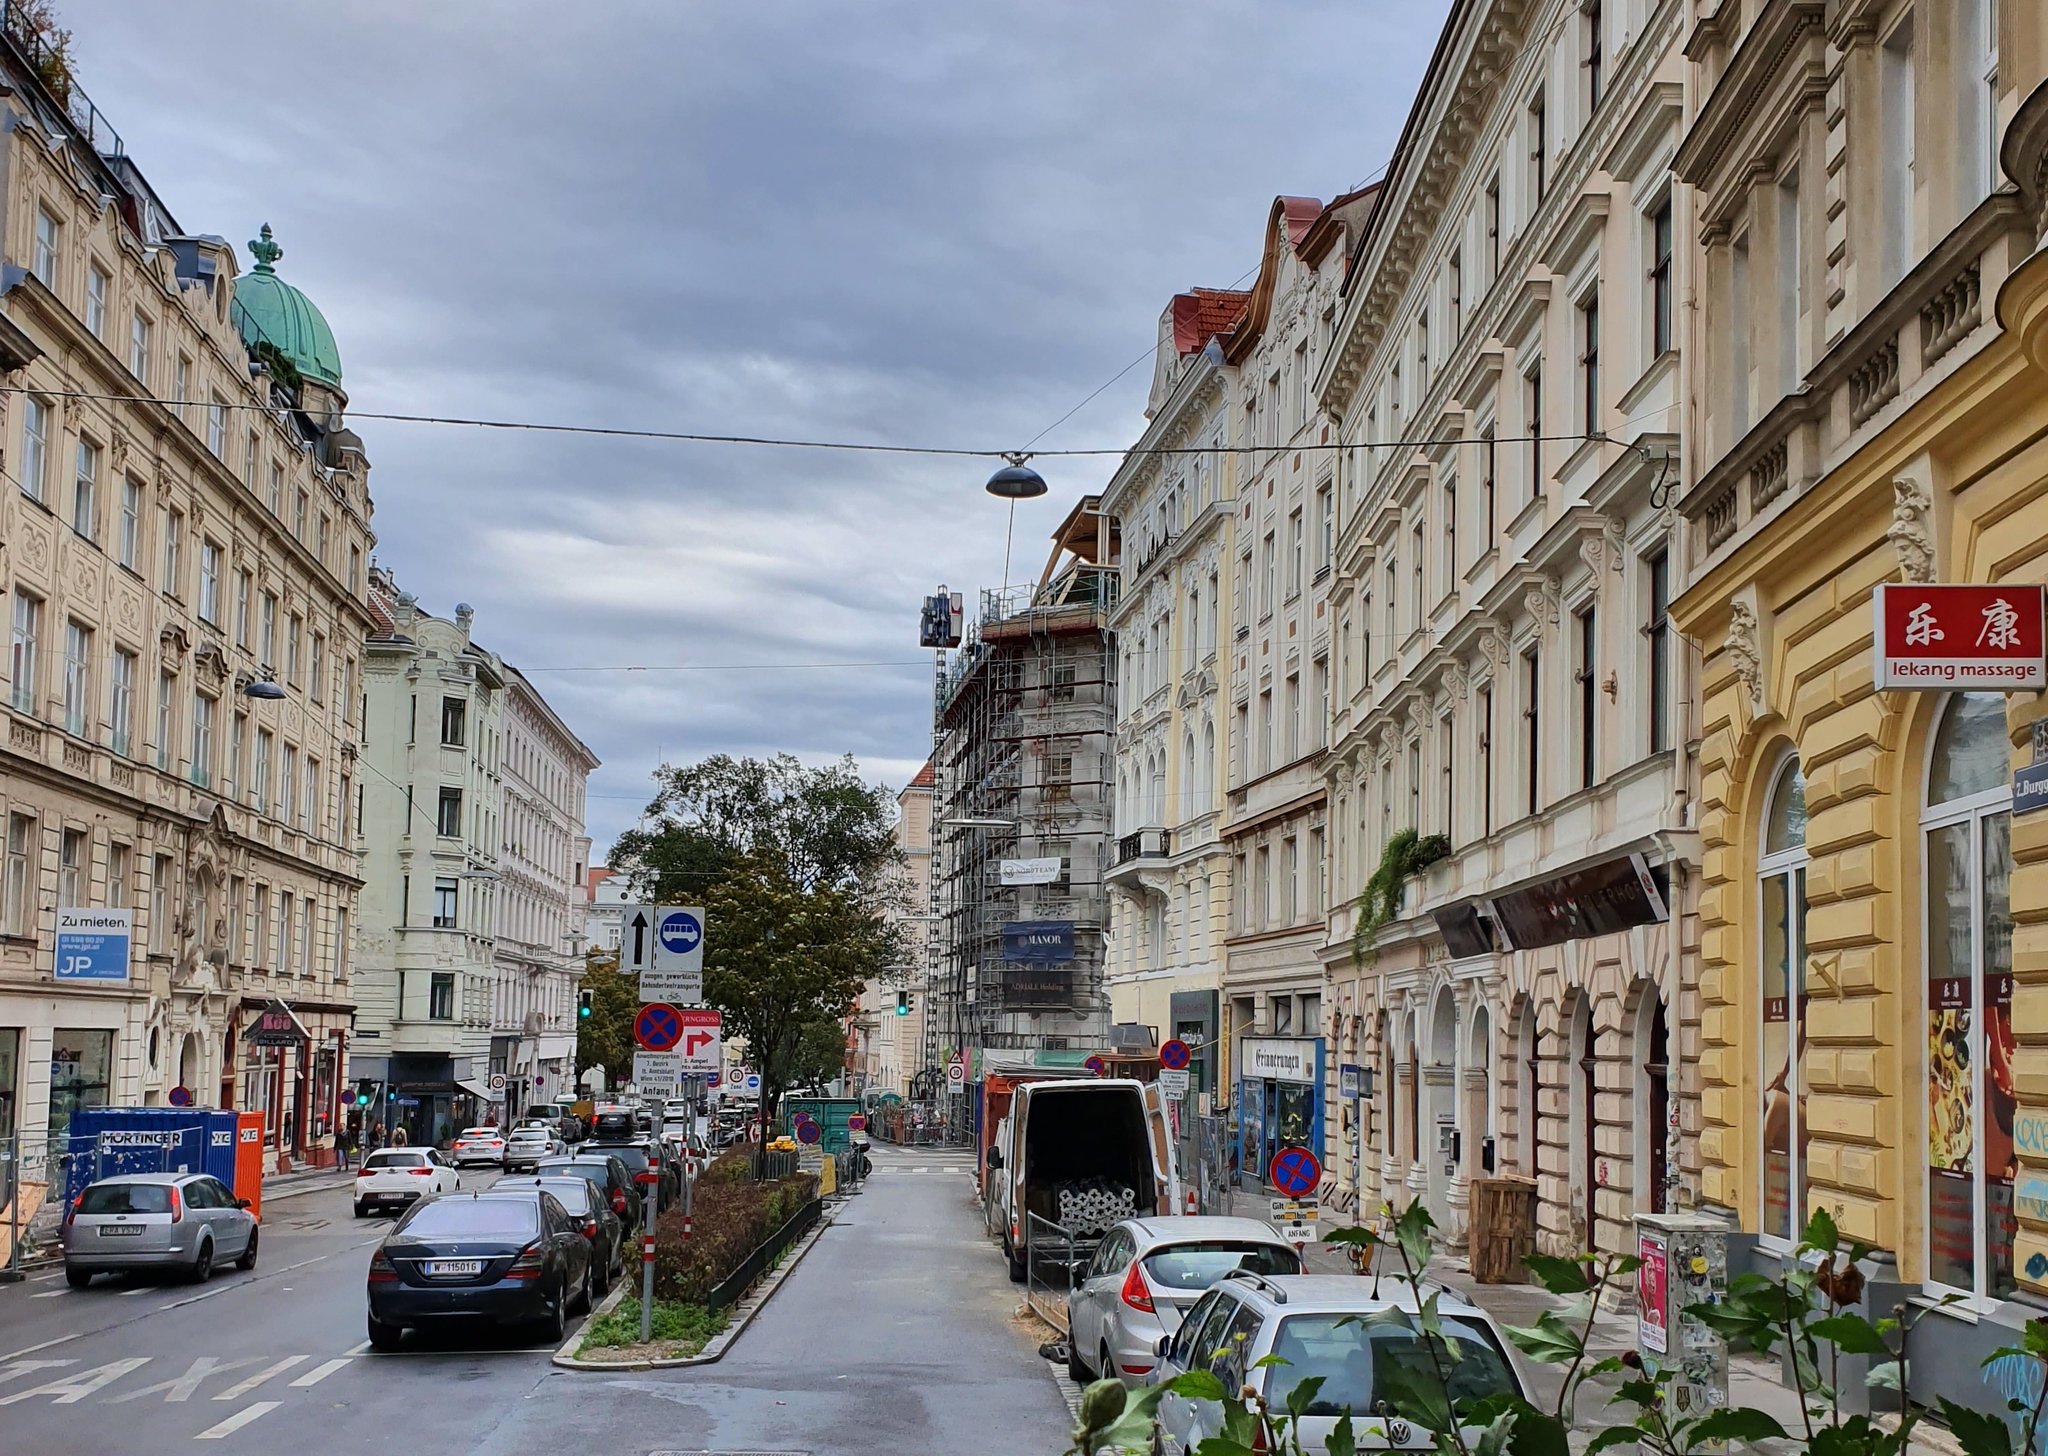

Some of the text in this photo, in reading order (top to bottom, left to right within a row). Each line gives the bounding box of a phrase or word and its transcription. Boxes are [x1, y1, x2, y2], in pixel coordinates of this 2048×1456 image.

[1893, 661, 2037, 680] lekang massage
[61, 915, 128, 928] Zu mieten.
[60, 955, 92, 975] JP
[1255, 1048, 1300, 1075] Erinnerungen
[643, 1086, 670, 1097] Anfang
[1272, 1202, 1284, 1210] Gilt
[1288, 1229, 1311, 1238] ANFANG
